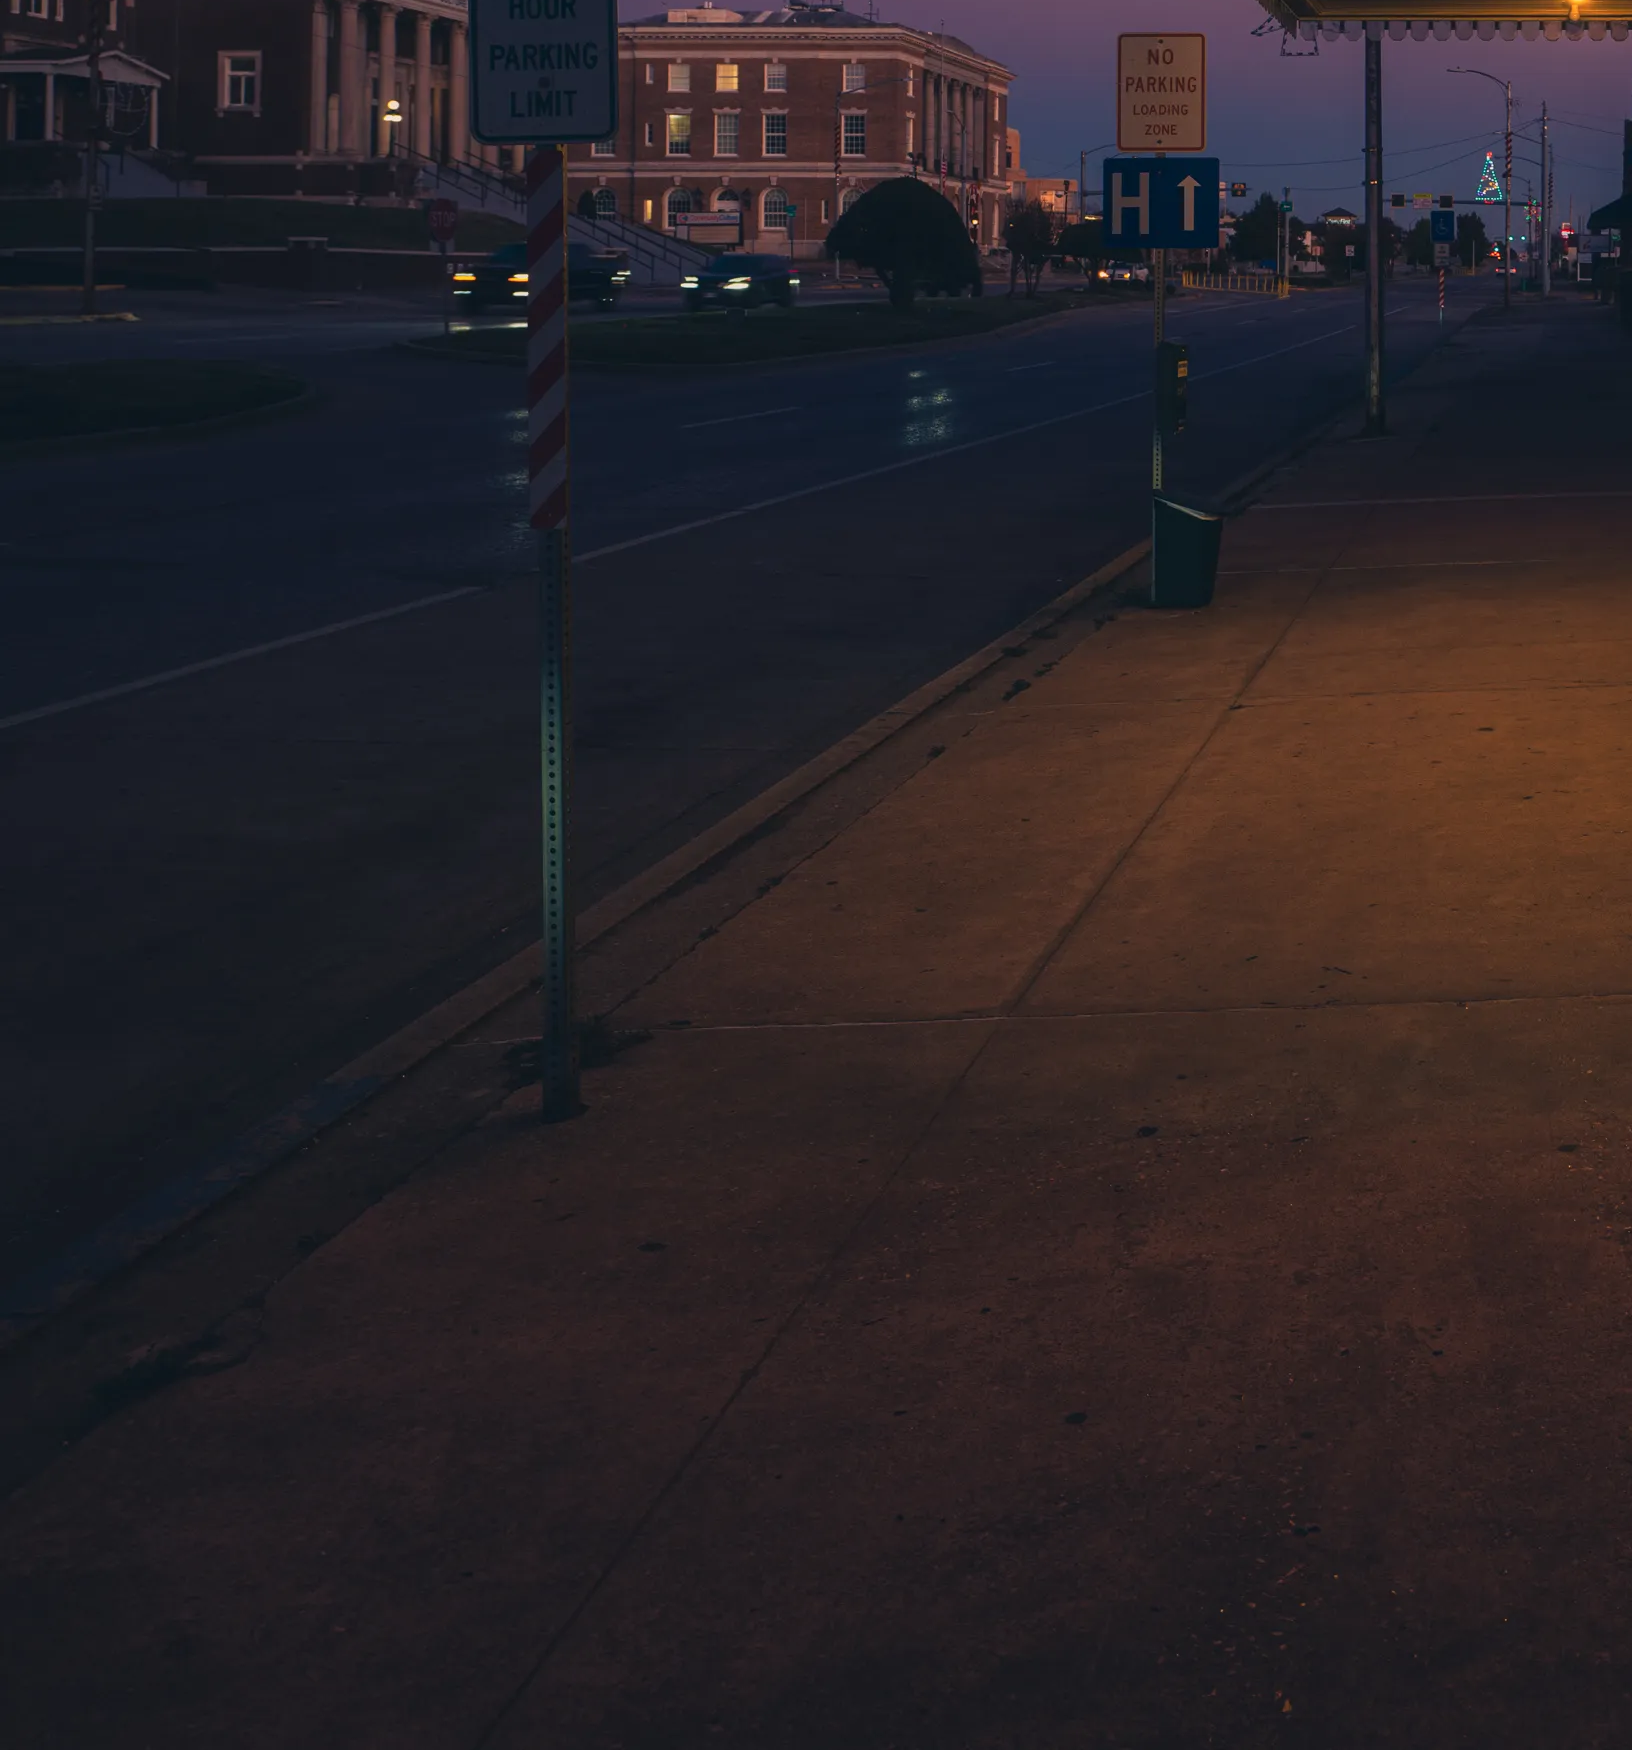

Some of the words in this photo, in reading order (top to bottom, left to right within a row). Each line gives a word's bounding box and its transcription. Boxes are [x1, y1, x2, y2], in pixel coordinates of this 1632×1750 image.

[489, 41, 599, 72] PARKING
[1147, 49, 1174, 65] NO
[1125, 76, 1197, 93] PARKING
[509, 89, 578, 118] LIMIT
[1133, 104, 1189, 116] LOADING
[1144, 124, 1178, 135] ZONE
[1111, 172, 1150, 235] H
[430, 211, 456, 228] STOP
